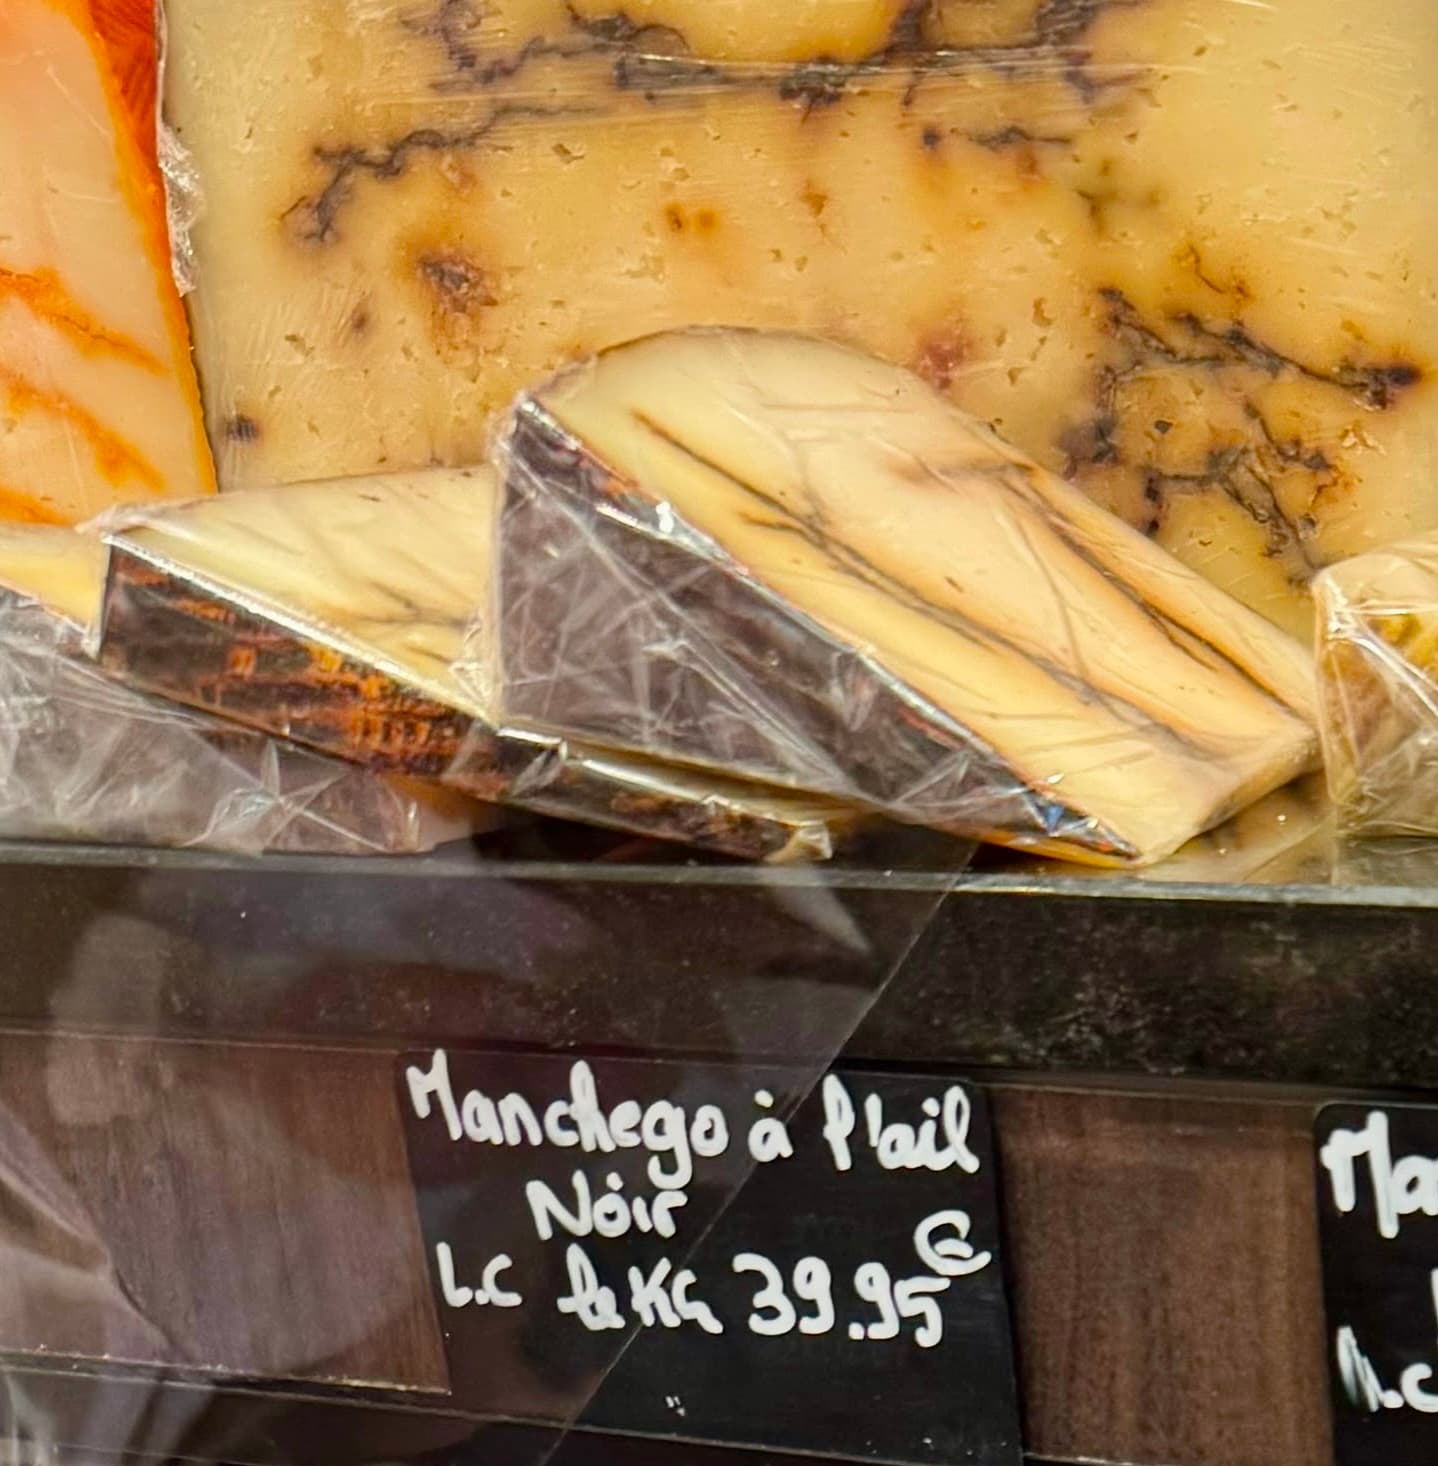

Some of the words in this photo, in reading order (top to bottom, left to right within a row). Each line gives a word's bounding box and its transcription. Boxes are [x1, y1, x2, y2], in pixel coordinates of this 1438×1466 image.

[406, 1048, 730, 1190] Manchego
[747, 1090, 794, 1162] à
[525, 1169, 688, 1241] Noir
[733, 1253, 951, 1348] 39.95
